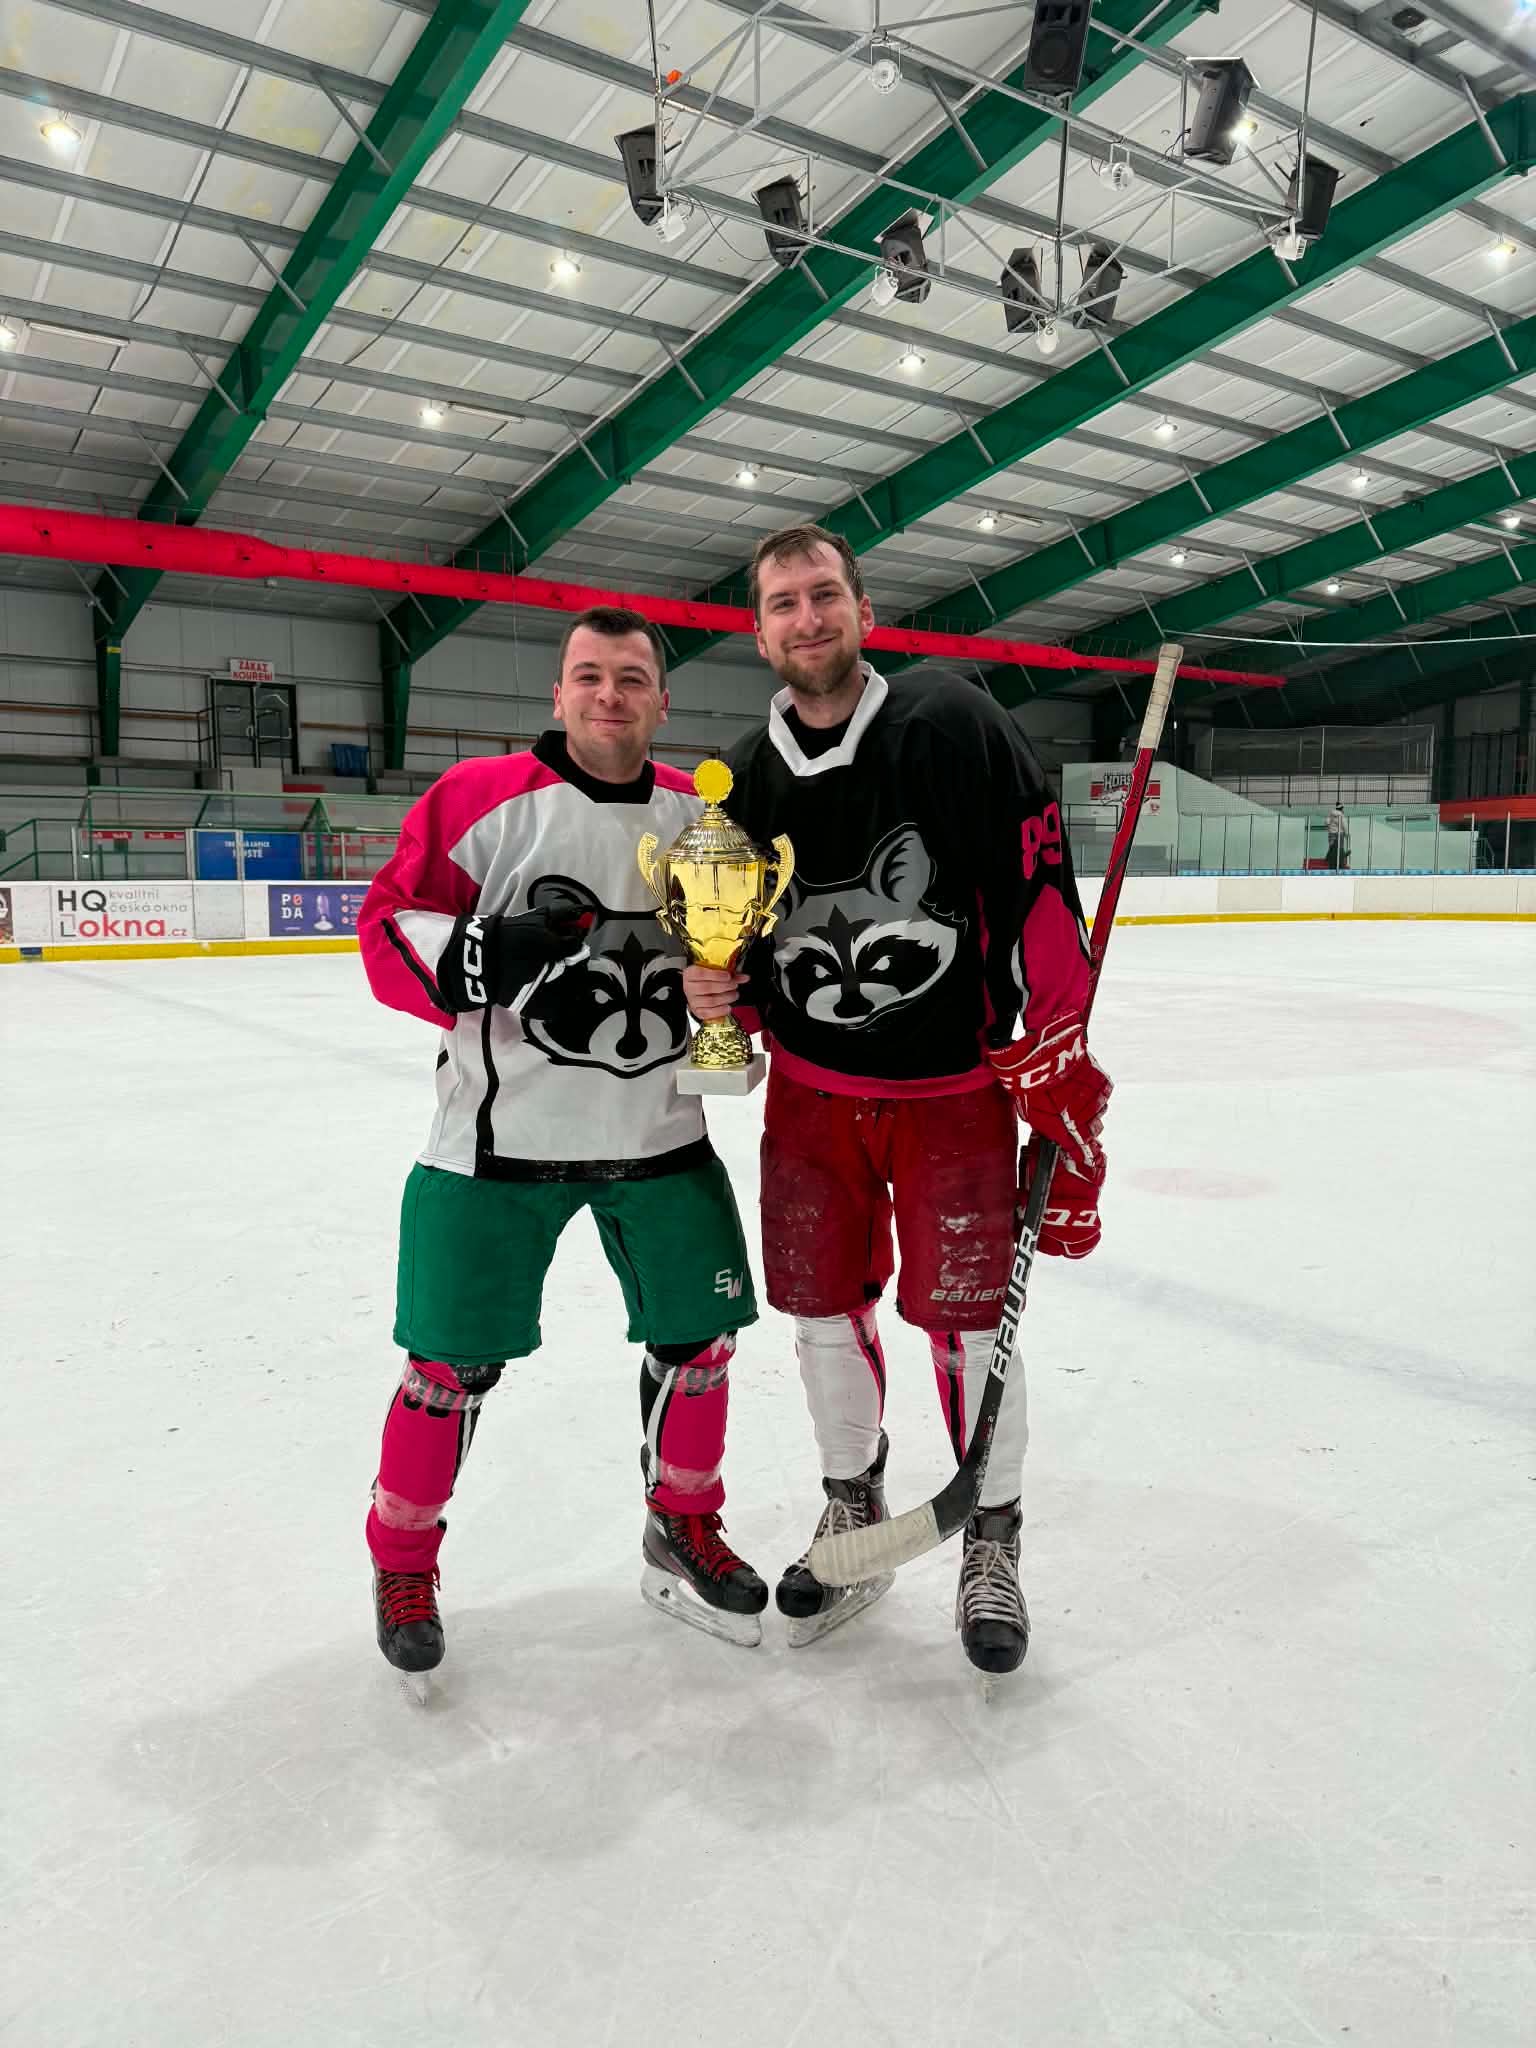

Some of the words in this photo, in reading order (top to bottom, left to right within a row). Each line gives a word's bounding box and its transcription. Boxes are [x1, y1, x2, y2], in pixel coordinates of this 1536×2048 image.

[1021, 800, 1062, 880] 89
[57, 889, 107, 912] HQ
[463, 915, 488, 1003] CCM
[714, 1268, 744, 1300] SW
[929, 1286, 1008, 1303] BAUER
[990, 1224, 1041, 1384] BAUER
